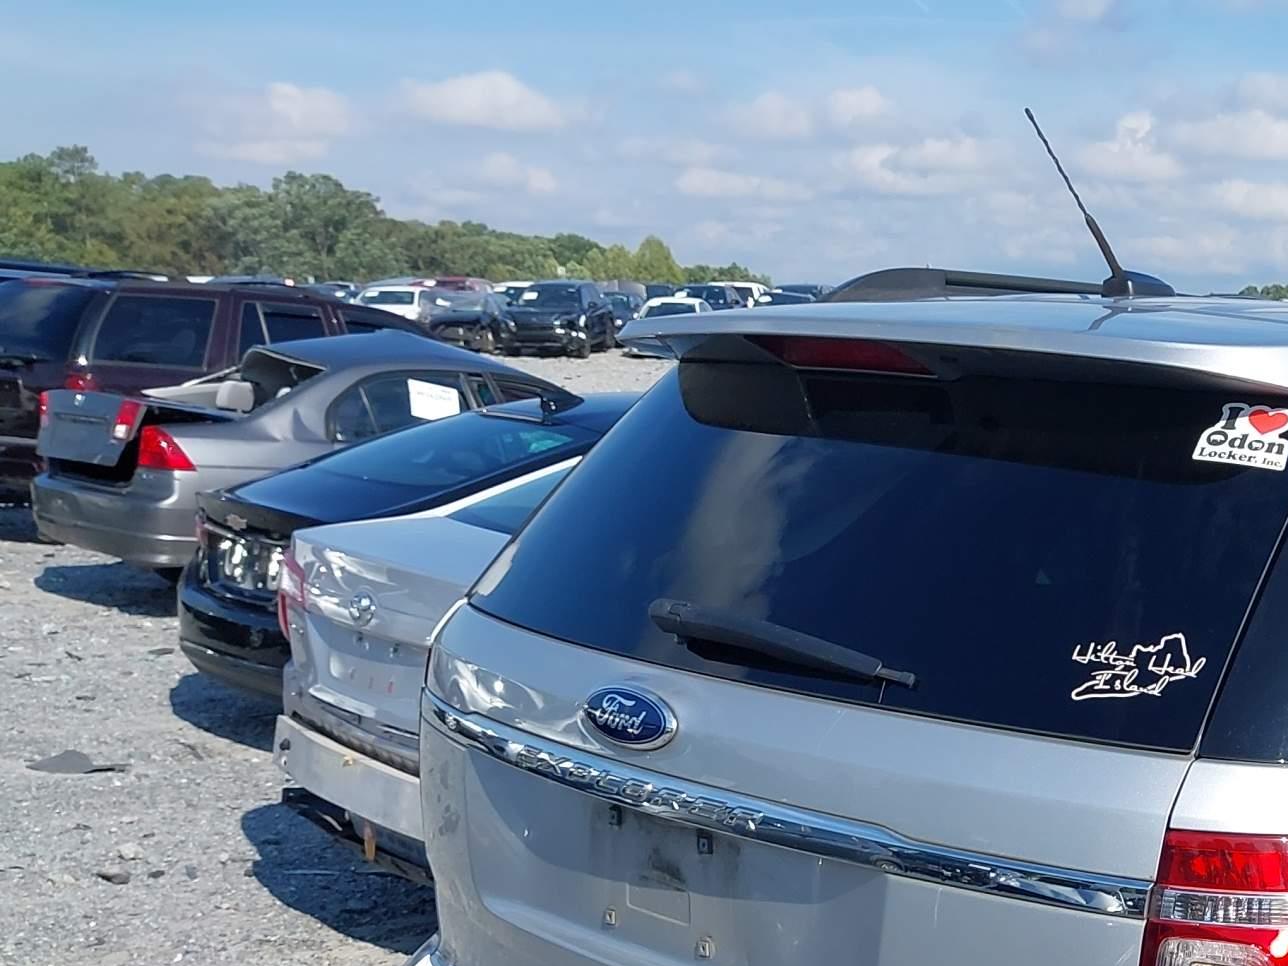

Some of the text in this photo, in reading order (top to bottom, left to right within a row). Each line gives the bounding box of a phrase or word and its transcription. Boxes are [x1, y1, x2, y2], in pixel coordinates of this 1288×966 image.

[1221, 406, 1245, 430] I
[1206, 430, 1285, 455] Odon
[1261, 457, 1283, 468] Inc.
[1072, 641, 1137, 669] Hilton
[588, 694, 646, 735] Ford
[515, 743, 766, 831] EXPLORER
